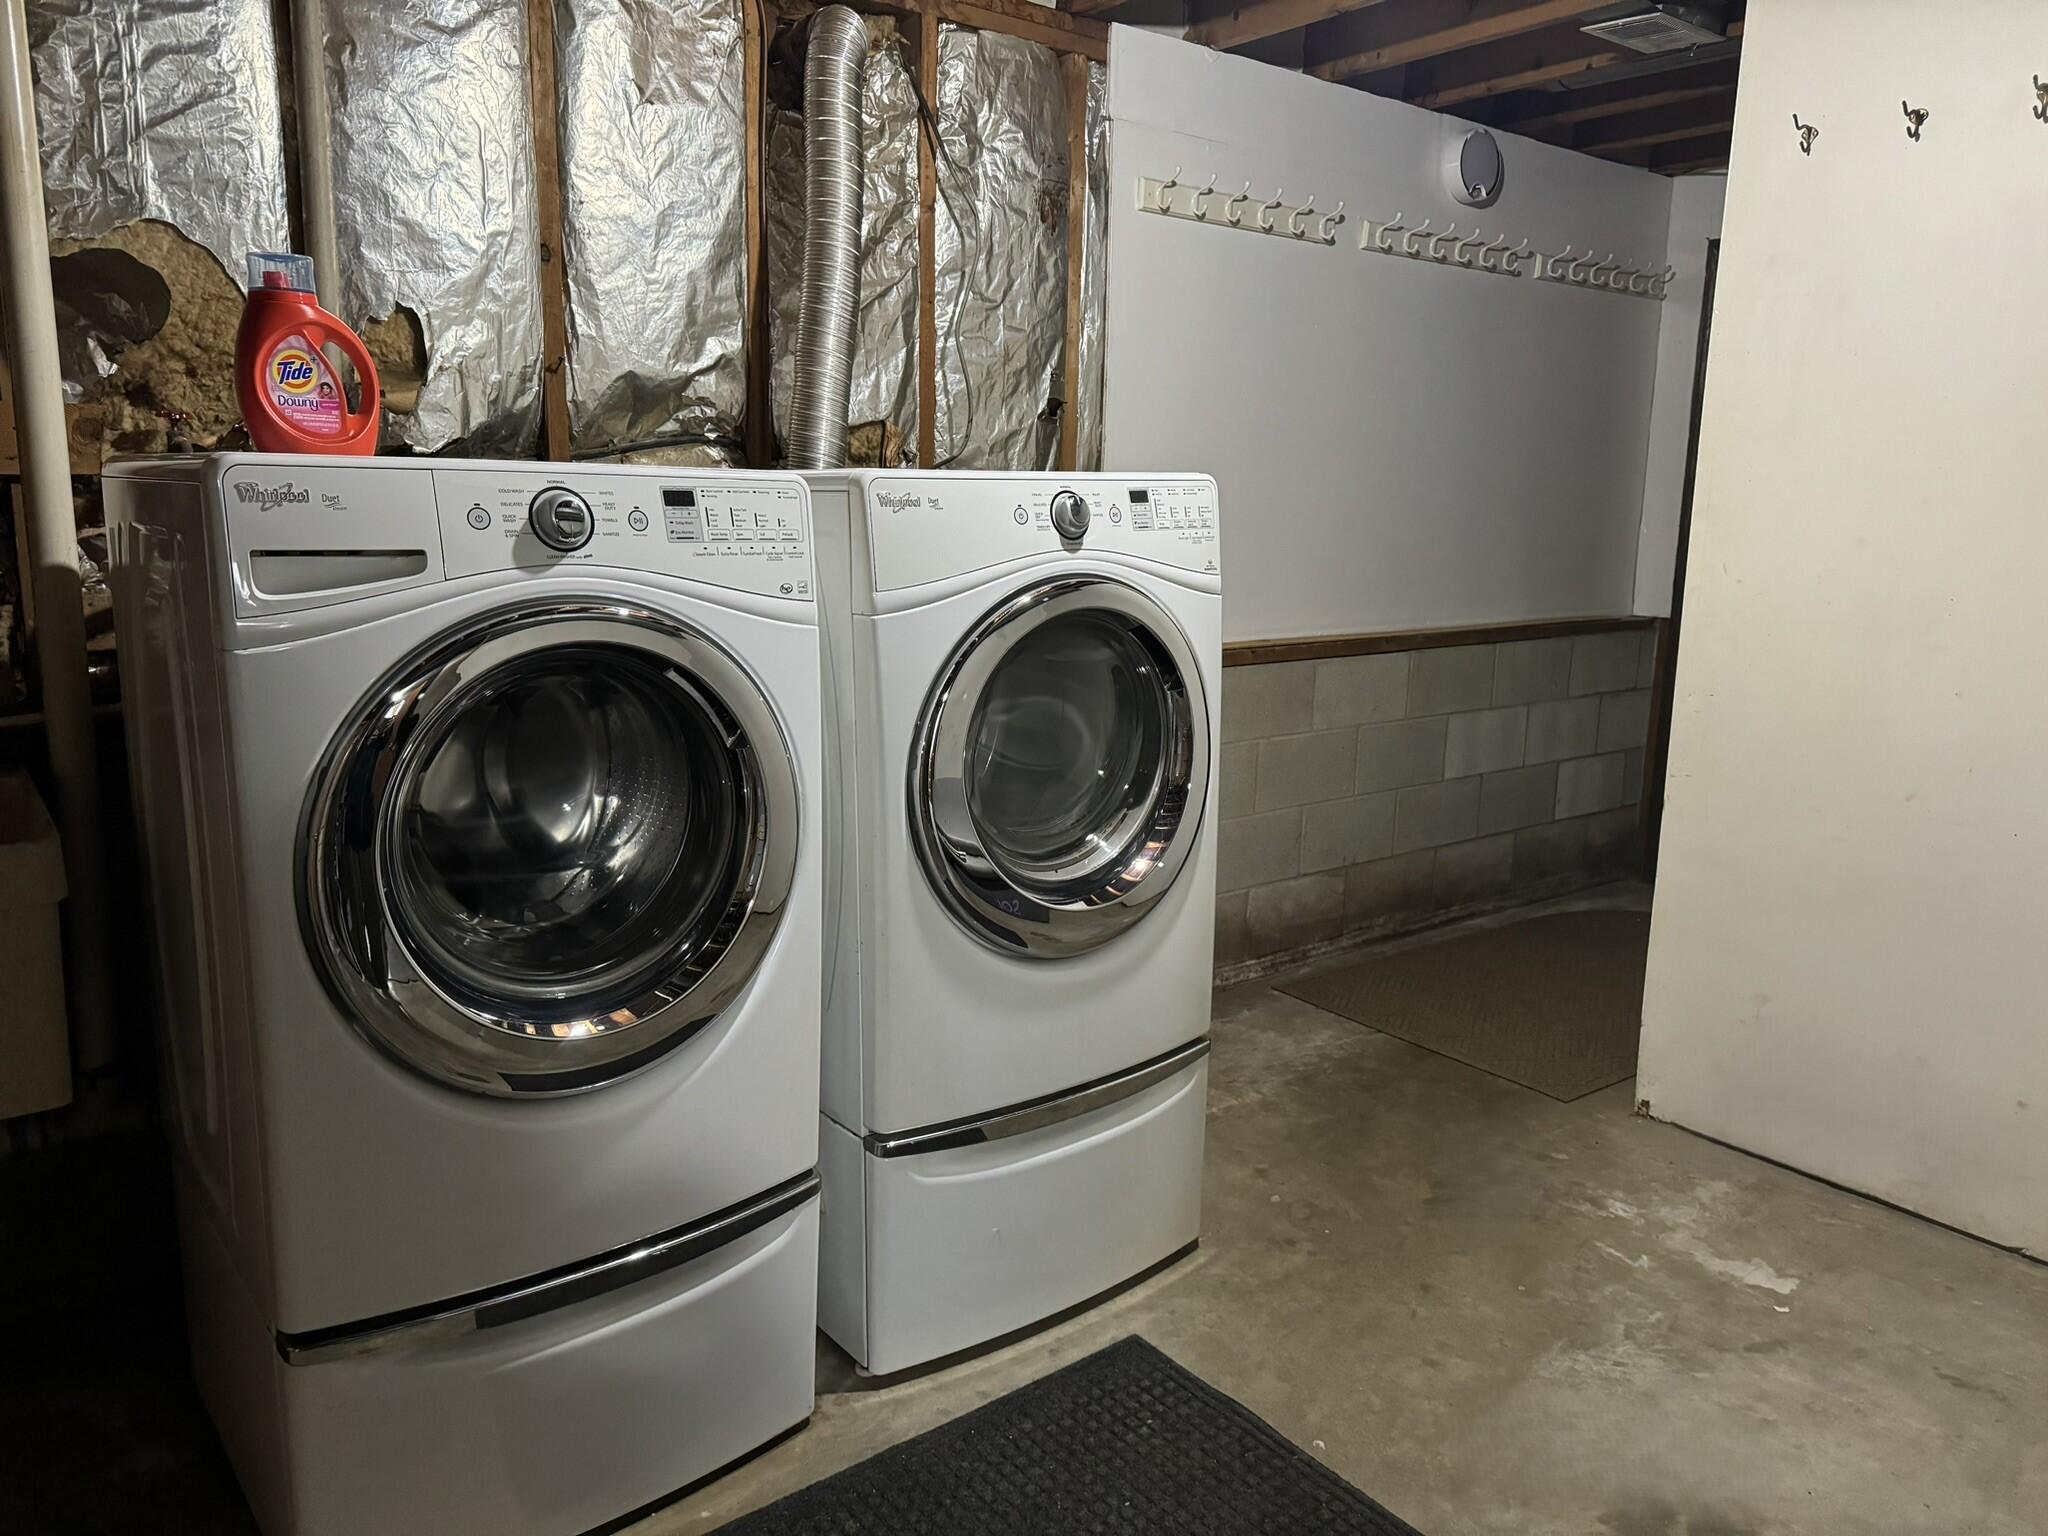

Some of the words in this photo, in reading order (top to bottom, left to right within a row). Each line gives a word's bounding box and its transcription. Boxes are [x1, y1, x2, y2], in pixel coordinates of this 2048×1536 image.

[277, 360, 313, 385] Tide
[277, 395, 319, 411] Downy
[233, 481, 310, 512] Whirlpool
[321, 493, 340, 503] Duet
[876, 492, 920, 513] Whirlpool
